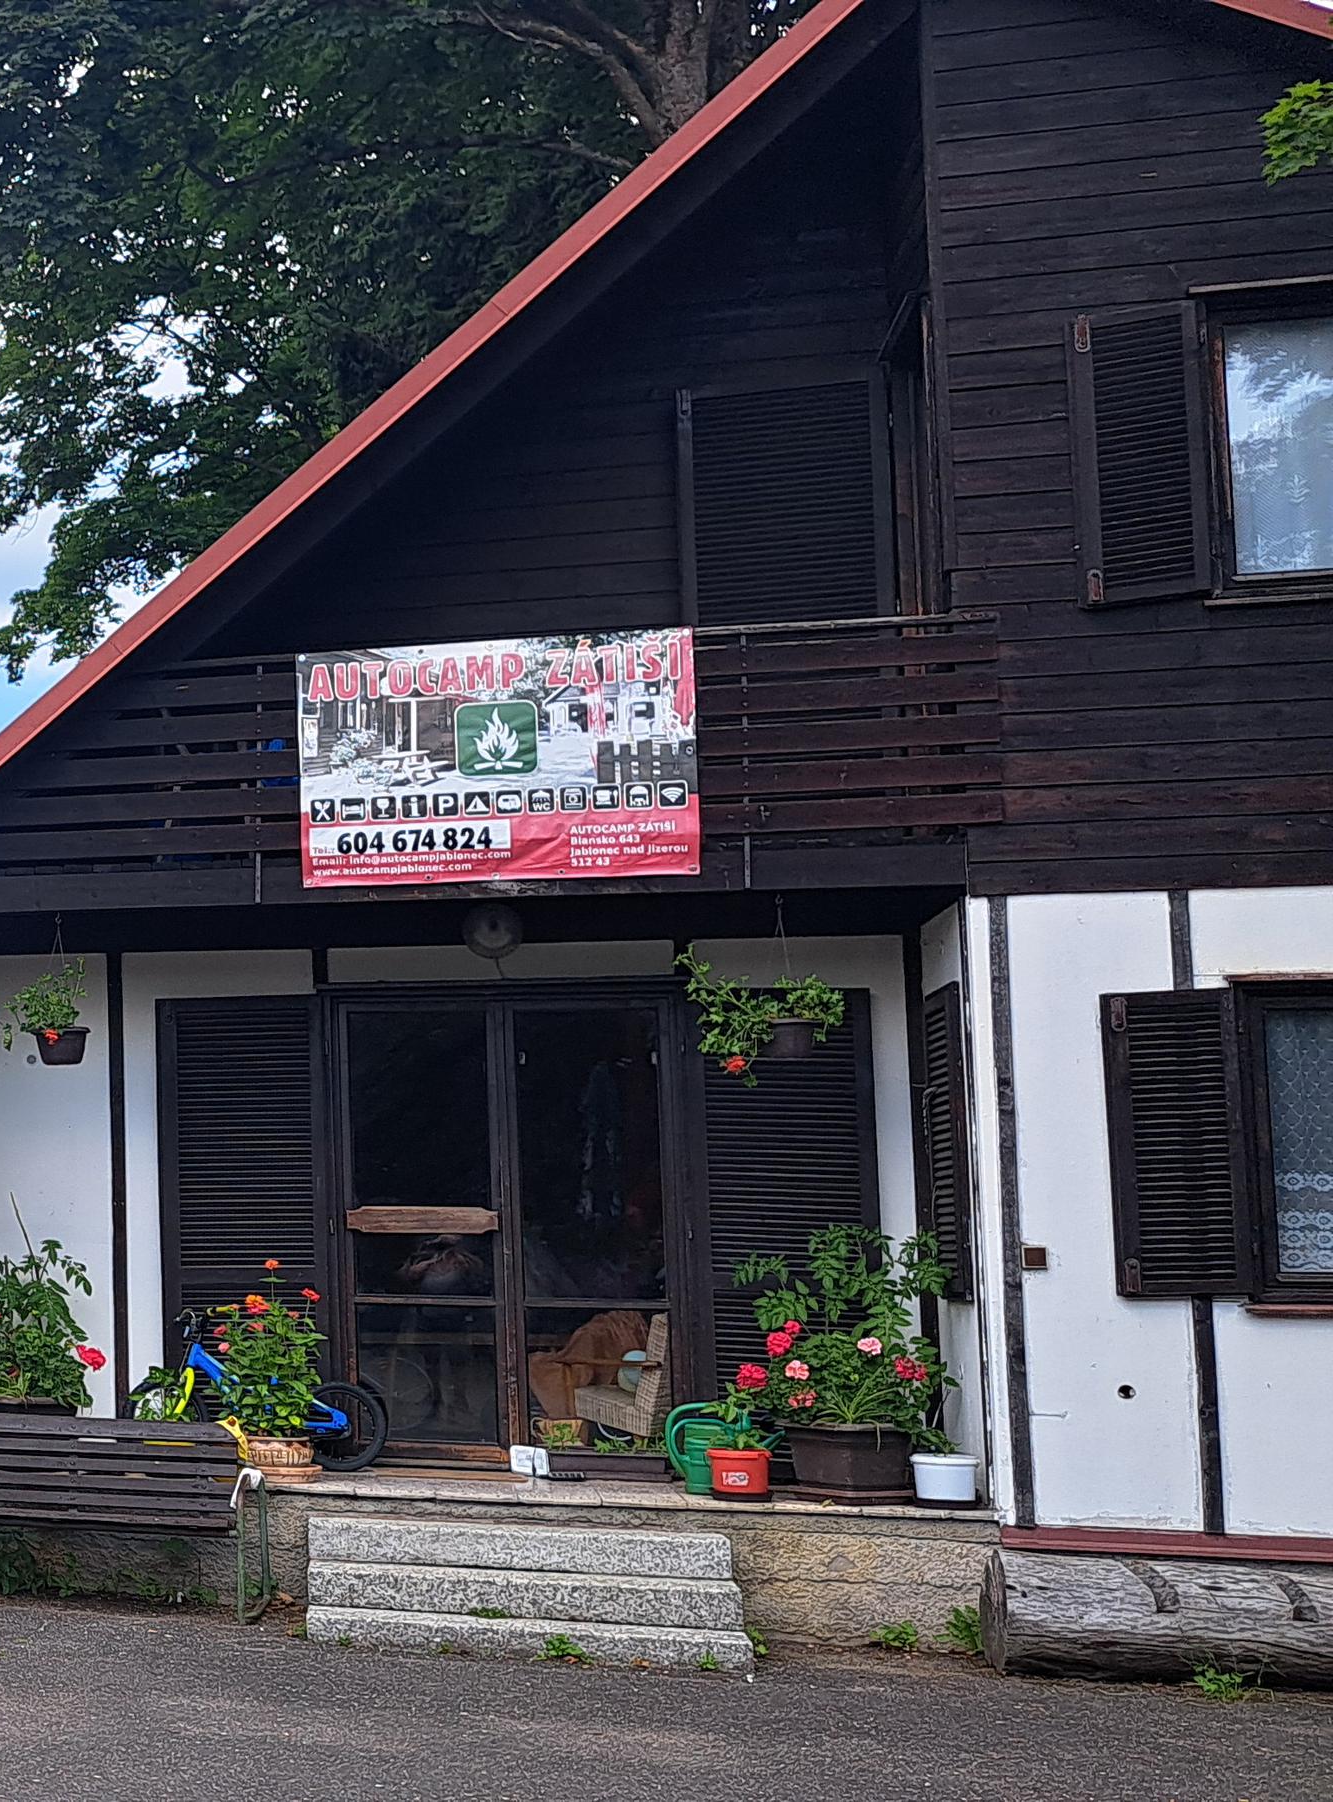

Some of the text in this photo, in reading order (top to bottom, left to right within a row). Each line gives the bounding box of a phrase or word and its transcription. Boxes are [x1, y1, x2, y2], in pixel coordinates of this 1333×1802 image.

[308, 638, 683, 702] AUTOCAMP ZÁTIŠÍ
[570, 820, 676, 834] AUTOCAMP ZÁTIŠÍ
[337, 832, 385, 854] 604
[391, 829, 436, 852] 674
[442, 826, 493, 850] 824
[570, 834, 640, 845] Blansko 643
[570, 844, 688, 857] Jablonec nad Jizerou
[312, 851, 511, 866] Email: info@autocampjablonec.com
[571, 857, 610, 867] 512 43
[313, 863, 472, 877] www.autocampjablonec.com
